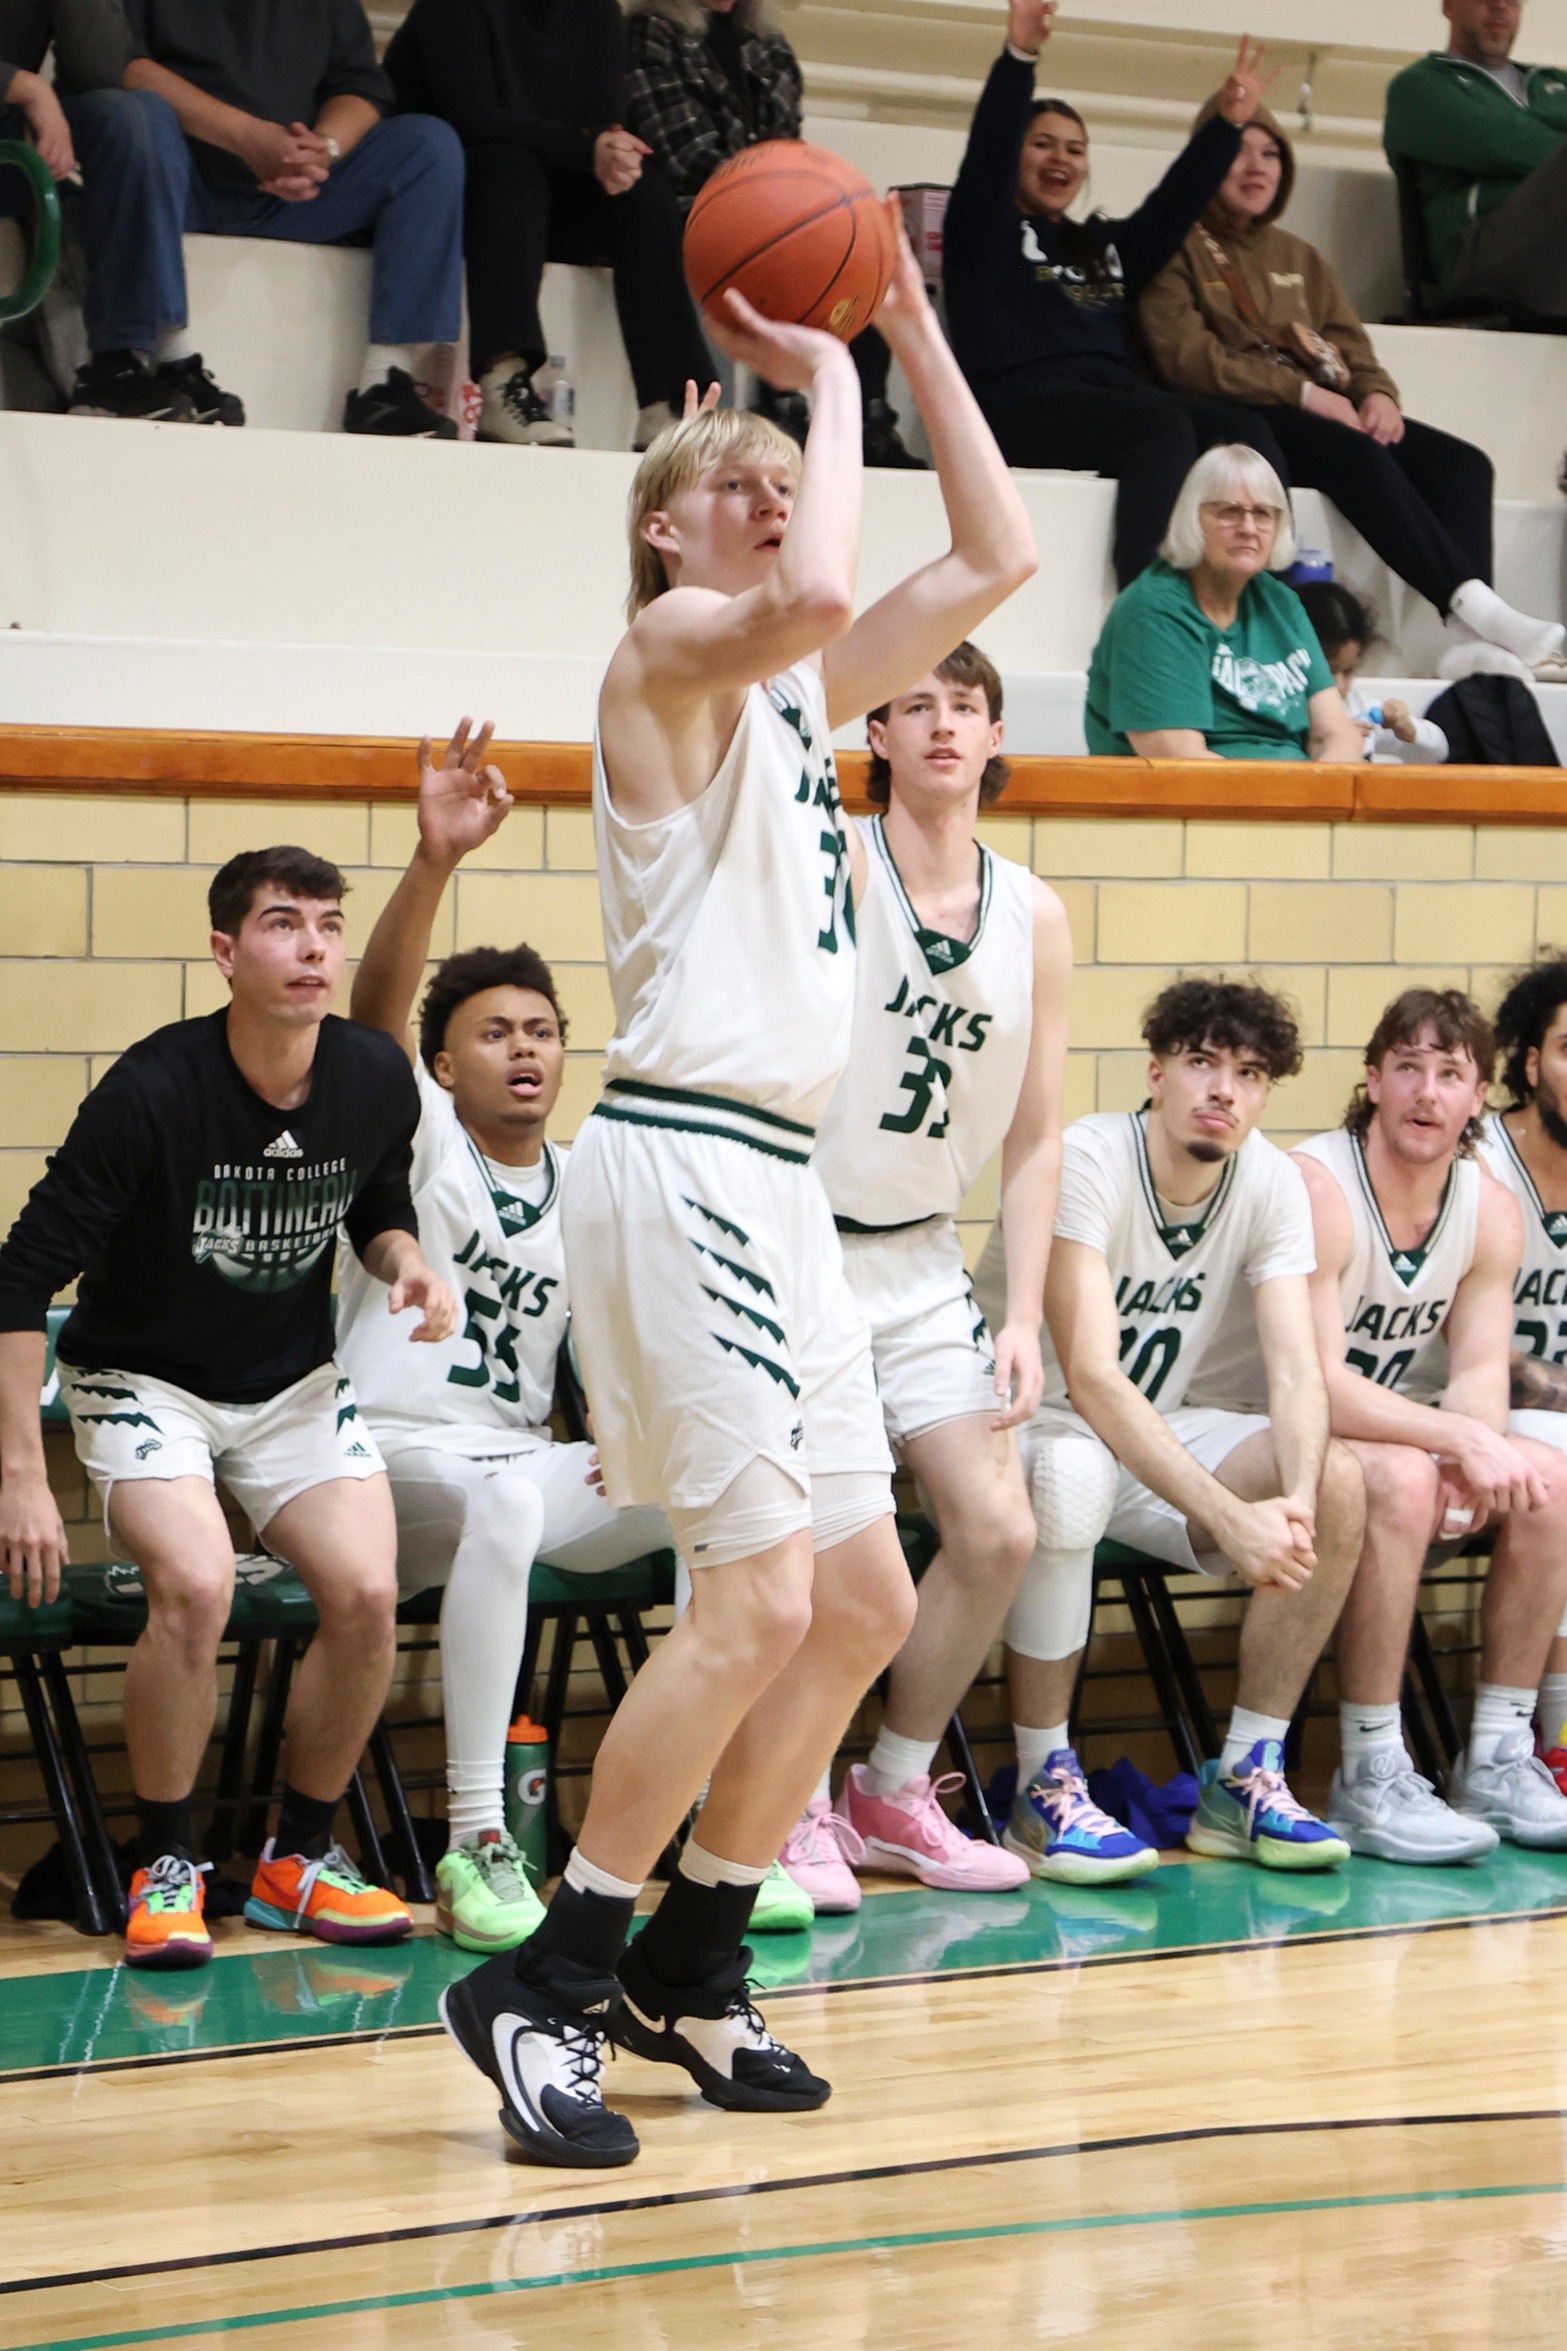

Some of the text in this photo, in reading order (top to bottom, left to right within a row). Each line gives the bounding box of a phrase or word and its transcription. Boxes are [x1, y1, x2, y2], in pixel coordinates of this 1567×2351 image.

[884, 974, 993, 1052] JCKS
[214, 1157, 346, 1181] DAKOTA COLLEGE
[263, 1147, 304, 1158] adidas
[193, 1170, 357, 1236] BOTTINEAU
[196, 1236, 240, 1256] JACKS
[1513, 1267, 1567, 1307] AC
[1345, 1295, 1448, 1341] JACKS
